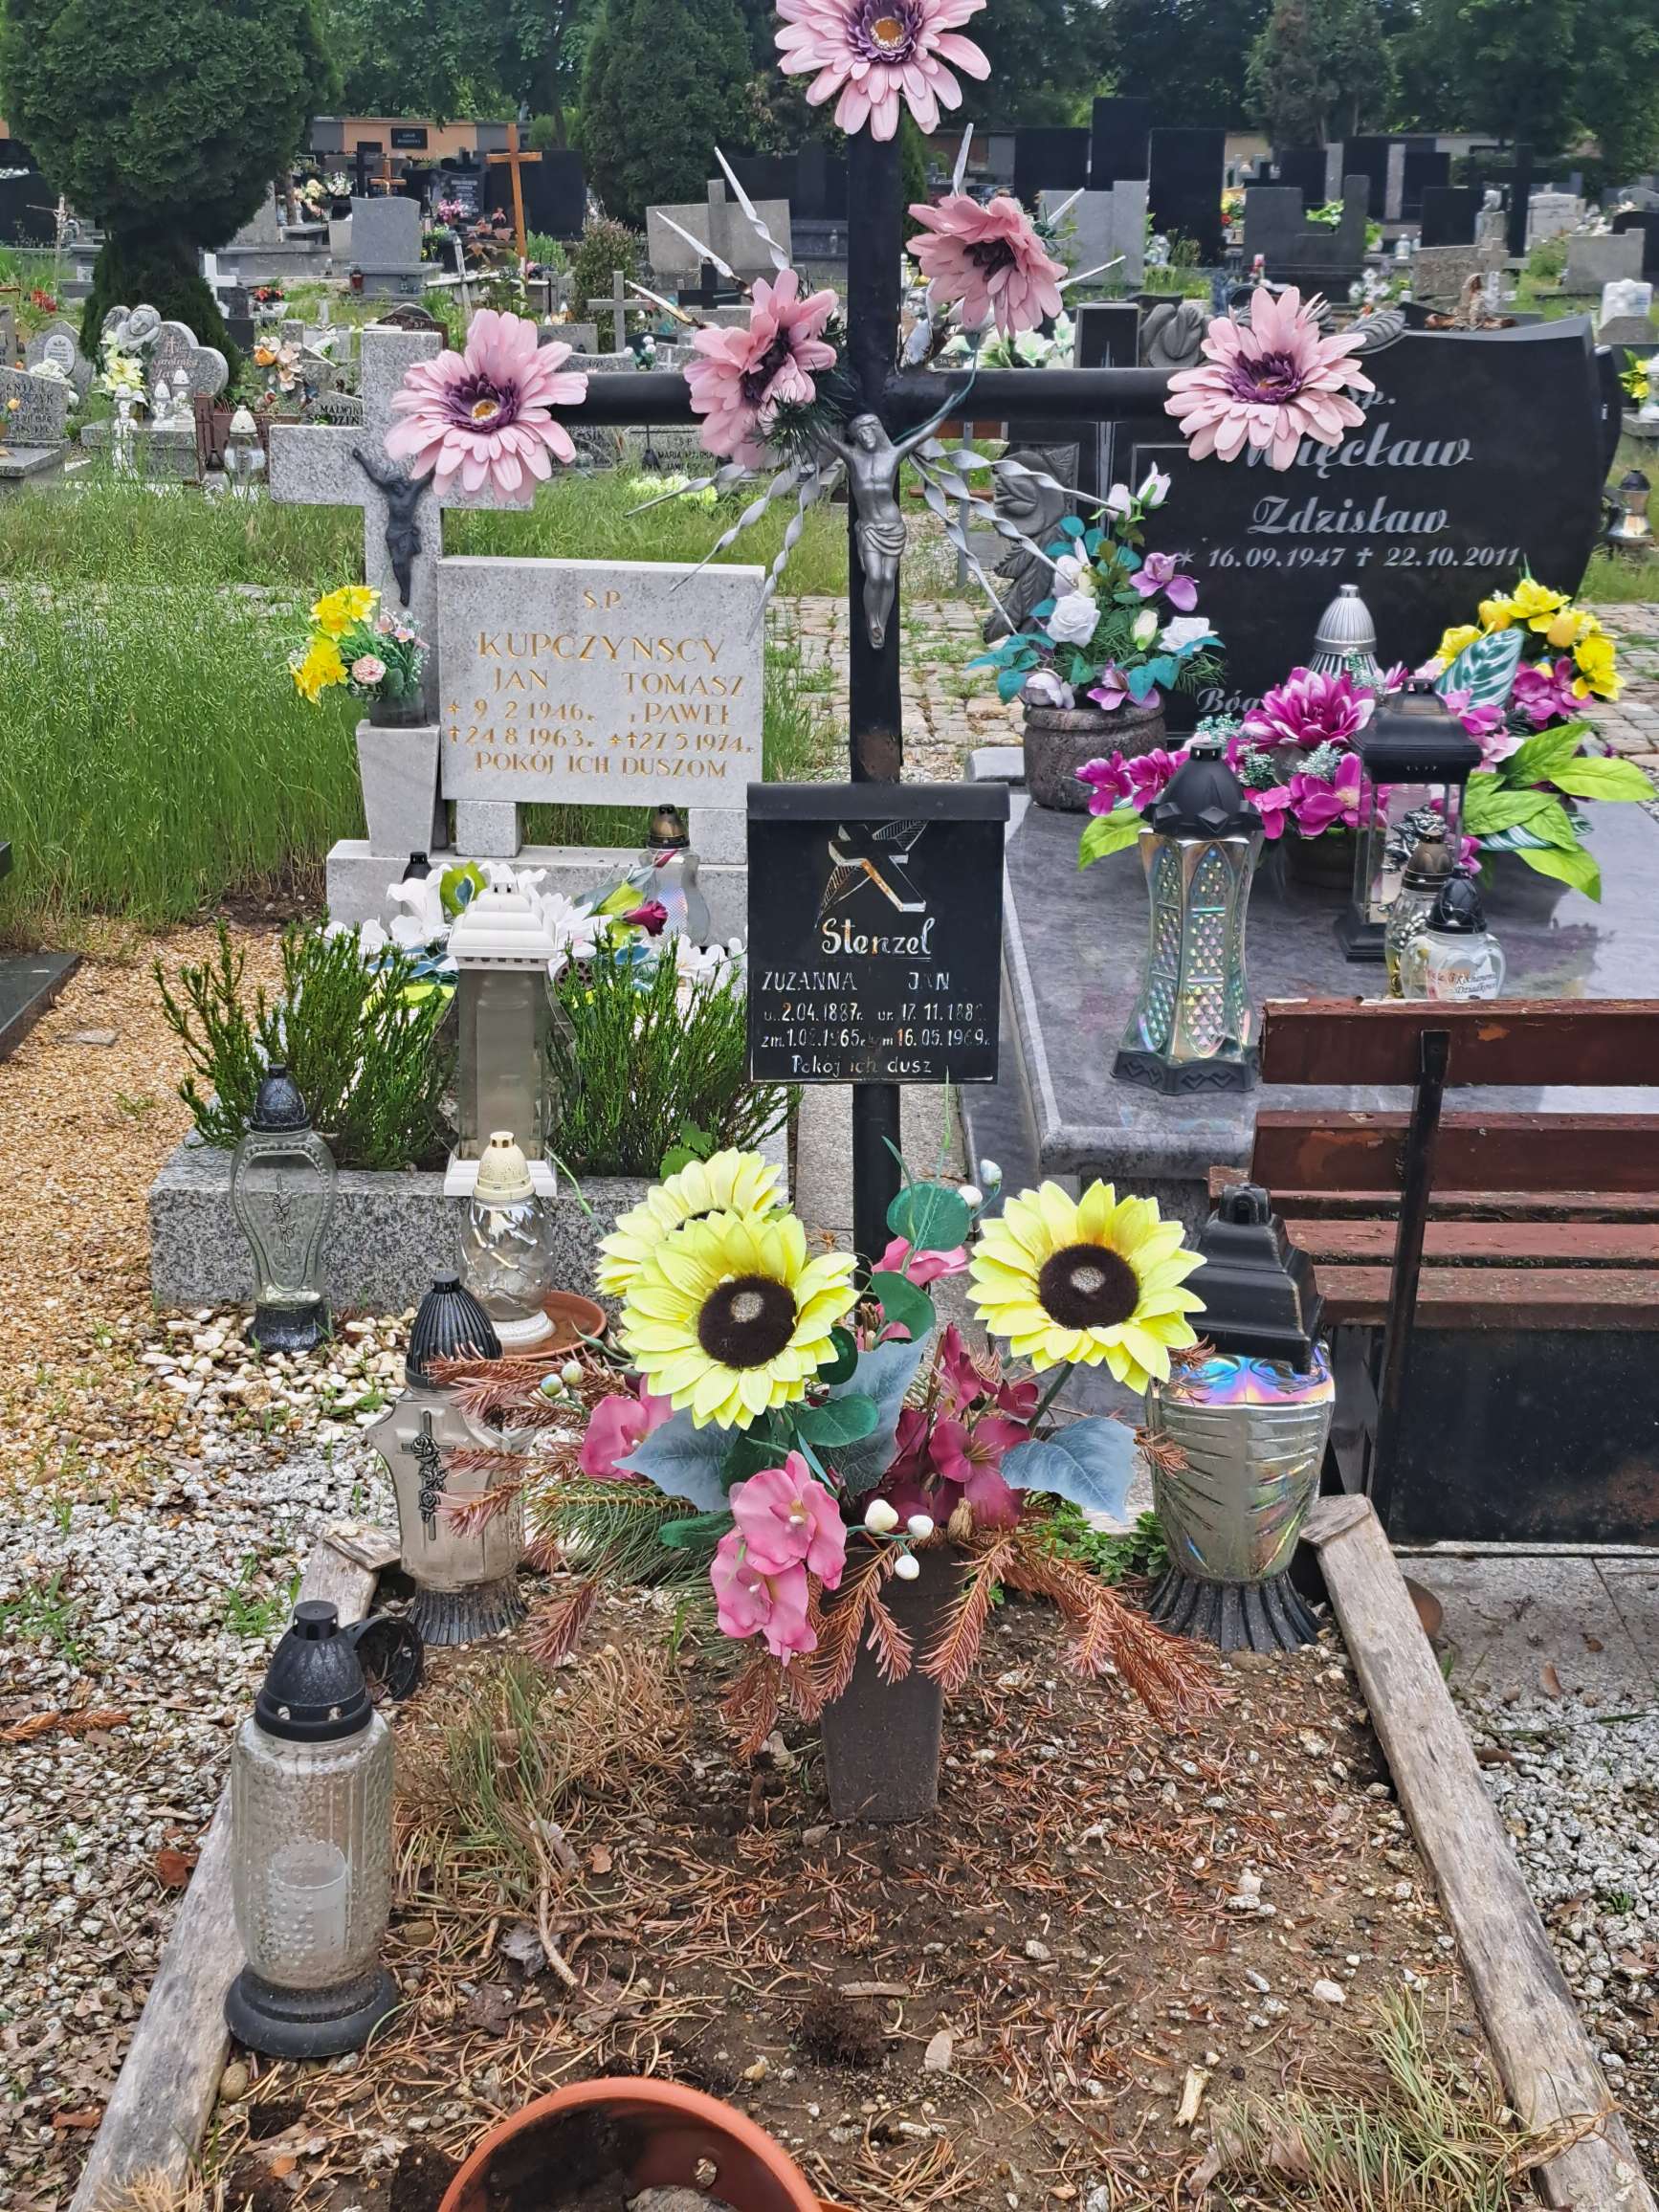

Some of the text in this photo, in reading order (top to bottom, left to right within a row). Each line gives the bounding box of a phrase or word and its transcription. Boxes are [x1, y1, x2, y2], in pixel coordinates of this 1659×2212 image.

[1247, 495, 1450, 536] Zdzisław
[1208, 546, 1520, 567] 16.09.1947 22.10.2011
[492, 668, 549, 695] JAN
[622, 672, 745, 697] TOMASZ
[644, 702, 736, 727] PAWEŁ
[475, 750, 728, 779] POKÓJ ICH DUSZOM
[821, 917, 936, 956] Stenzel
[761, 970, 859, 992] ZUZANNA
[850, 1055, 877, 1073] ich
